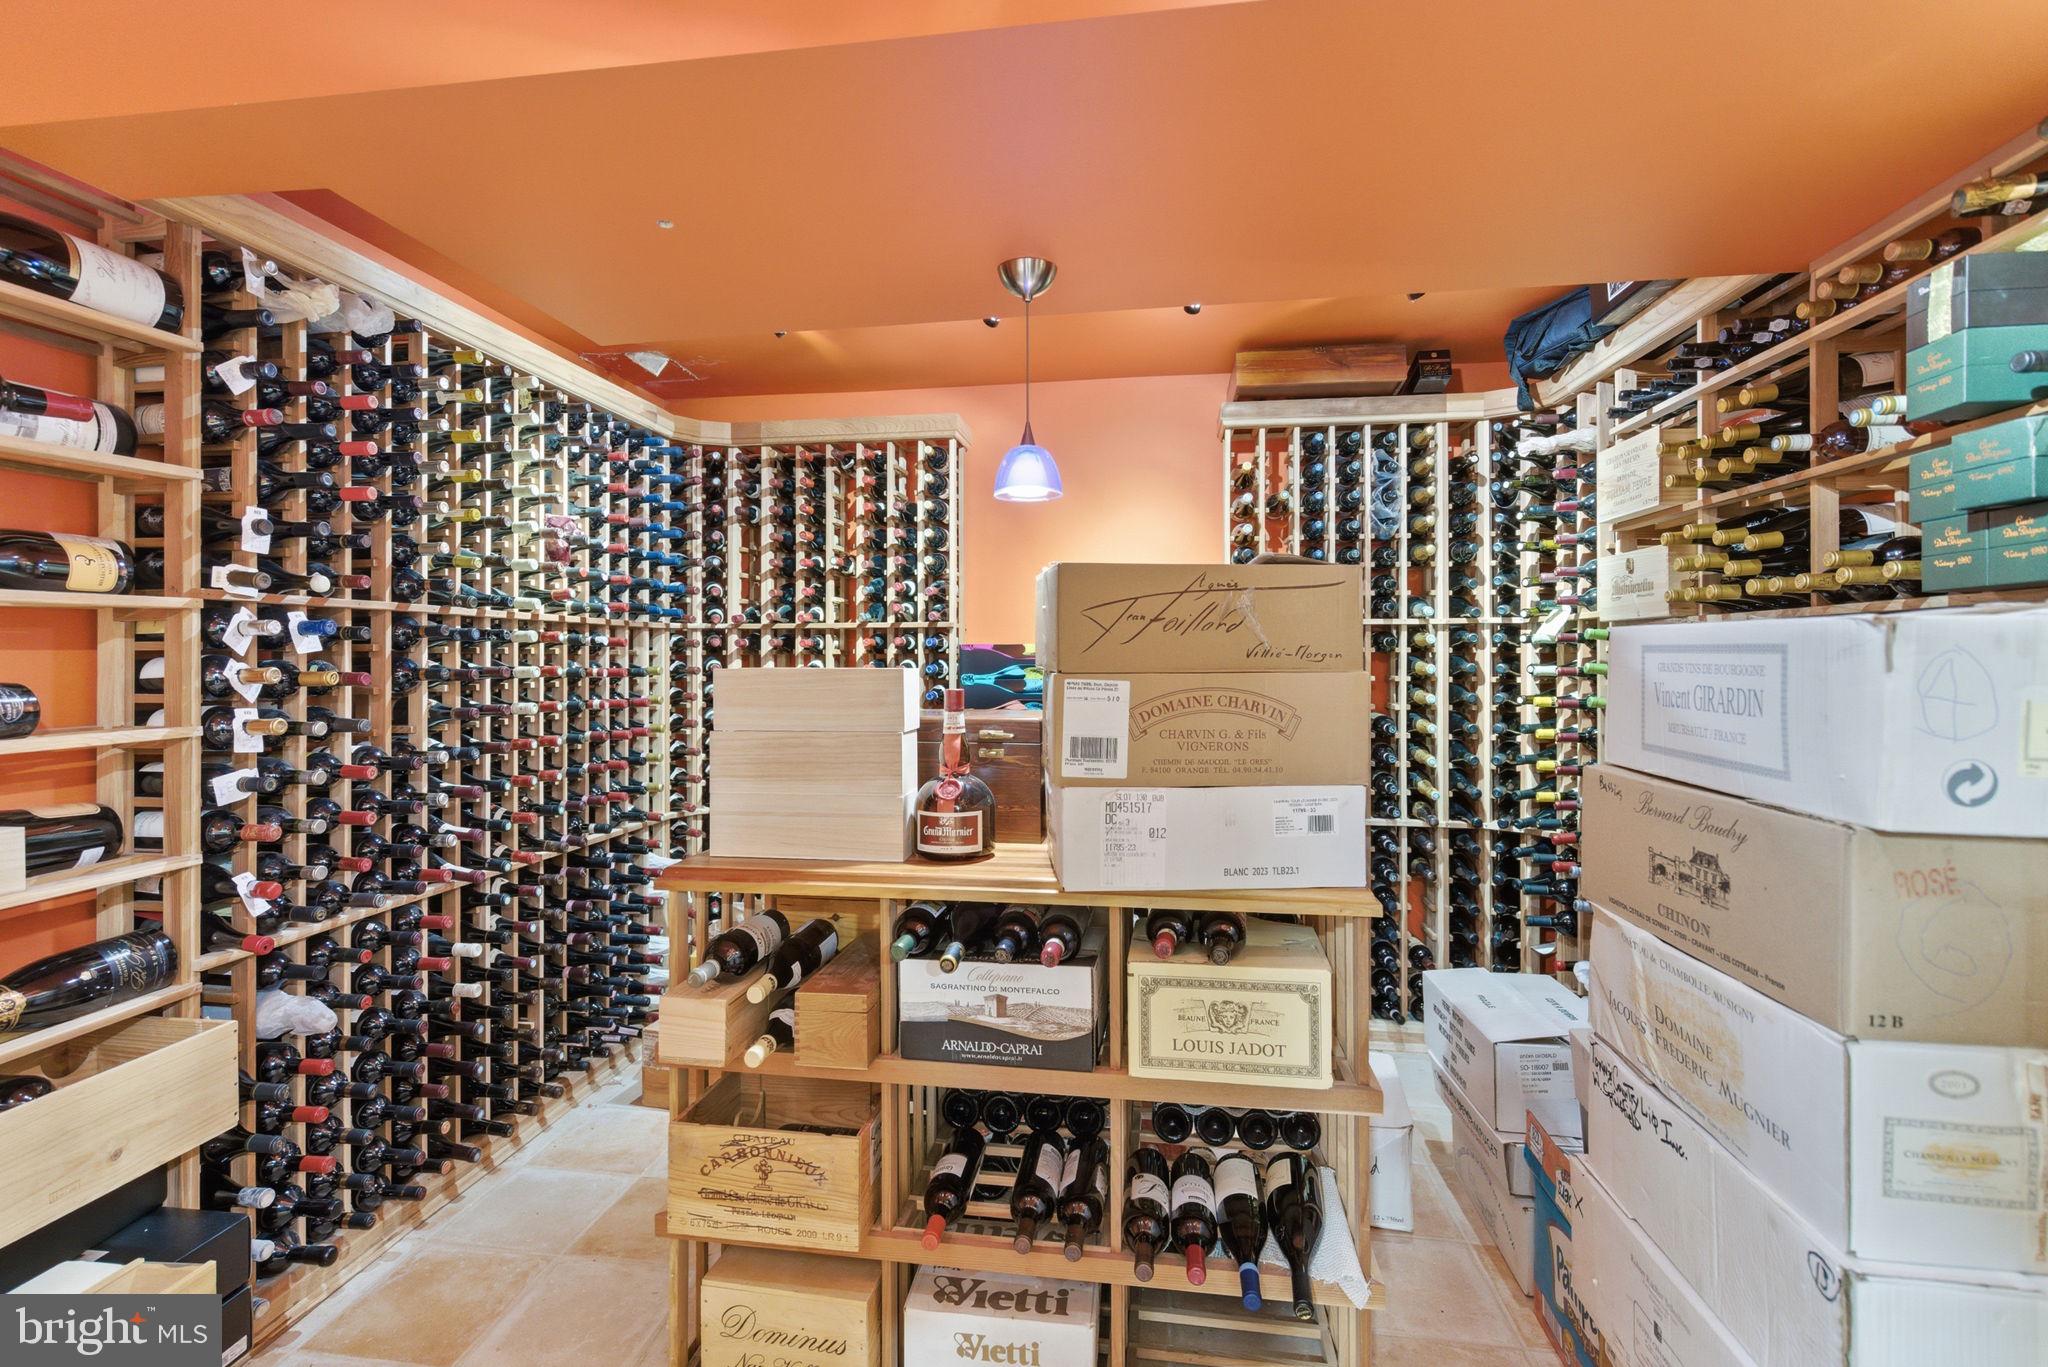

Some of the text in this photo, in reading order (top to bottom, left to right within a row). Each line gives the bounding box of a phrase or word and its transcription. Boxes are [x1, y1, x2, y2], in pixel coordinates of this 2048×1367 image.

[1713, 663, 1766, 677] BOURGOGNE
[1654, 680, 1764, 718] Vincent GIRARDIN
[1138, 694, 1288, 724] DOMAINE CHARVIN
[1159, 729, 1266, 740] CHARVIN G. & Fils
[1713, 728, 1747, 745] FRANCE
[1177, 741, 1249, 751] VIGNERONS
[1153, 758, 1181, 766] CHEMIN
[1175, 766, 1210, 774] ORANGE
[1633, 790, 1750, 853] Bernard Baudry
[1223, 866, 1300, 877] BLANC 2023 TLB23.1
[1657, 902, 1711, 939] CHINON
[930, 982, 986, 993] SAGRANTINO
[1000, 986, 1060, 996] MONTEFALCO
[1177, 1013, 1281, 1027] BEAUNE FRANCE
[1868, 1014, 1904, 1030] 12 B
[1654, 1004, 1714, 1063] DOMAINE
[1172, 1038, 1287, 1058] LOUIS JADOT
[1718, 1078, 1791, 1151] MUGNIER
[700, 1146, 829, 1187] CARBONNIEUX
[757, 1225, 792, 1236] ROUGE
[933, 1275, 1070, 1316] Vietti
[719, 1304, 848, 1356] Dominus
[953, 1332, 1041, 1367] Vietti
